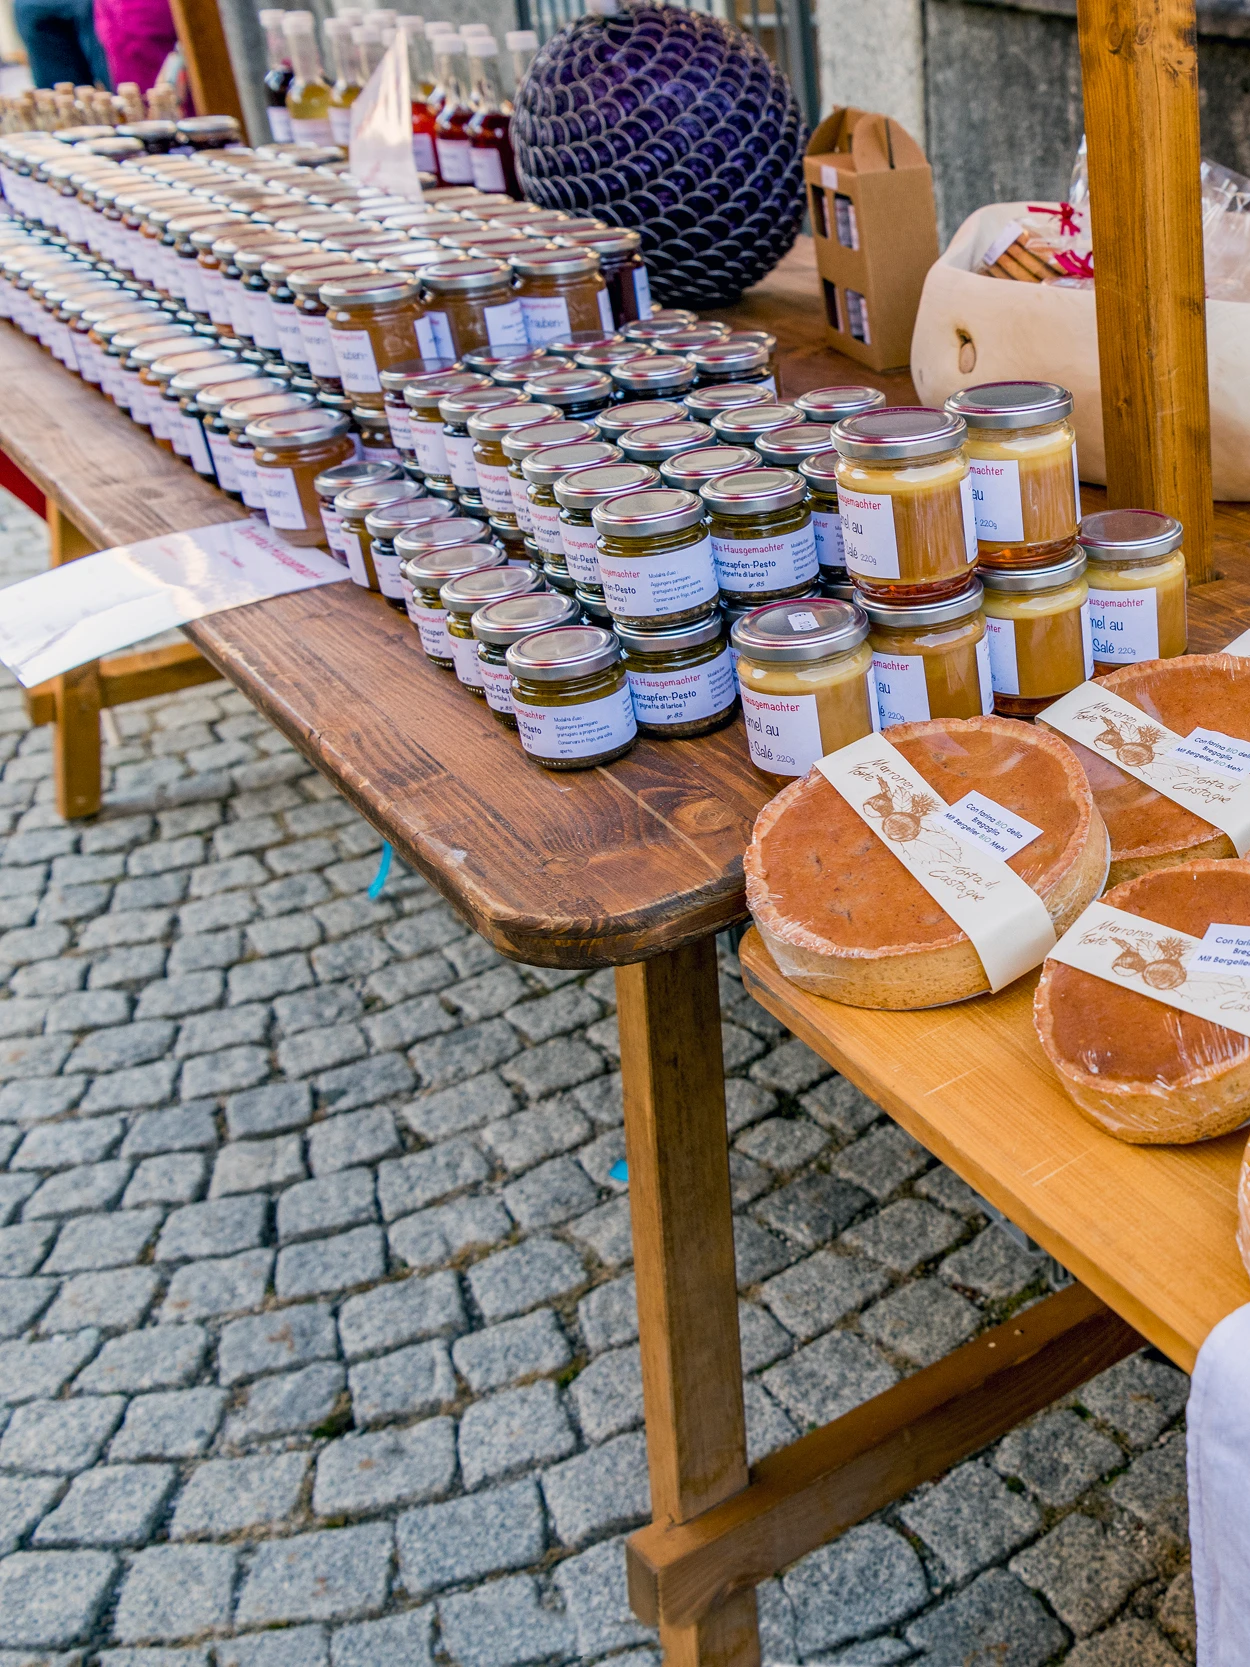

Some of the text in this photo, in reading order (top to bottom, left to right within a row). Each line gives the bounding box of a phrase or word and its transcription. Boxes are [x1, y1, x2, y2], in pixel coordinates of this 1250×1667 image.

[969, 464, 1004, 476] machter
[851, 521, 863, 535] au
[979, 519, 998, 530] 220g
[723, 543, 785, 557] Hausgemachter
[860, 553, 877, 565] 220g
[1109, 619, 1124, 631] au
[1092, 637, 1137, 656] Salé 220g
[873, 659, 910, 671] emachter
[639, 674, 701, 690] Hausgemachter
[878, 681, 891, 694] au
[887, 711, 905, 722] 220g
[765, 724, 780, 737] au
[754, 740, 796, 766] Salé 220g
